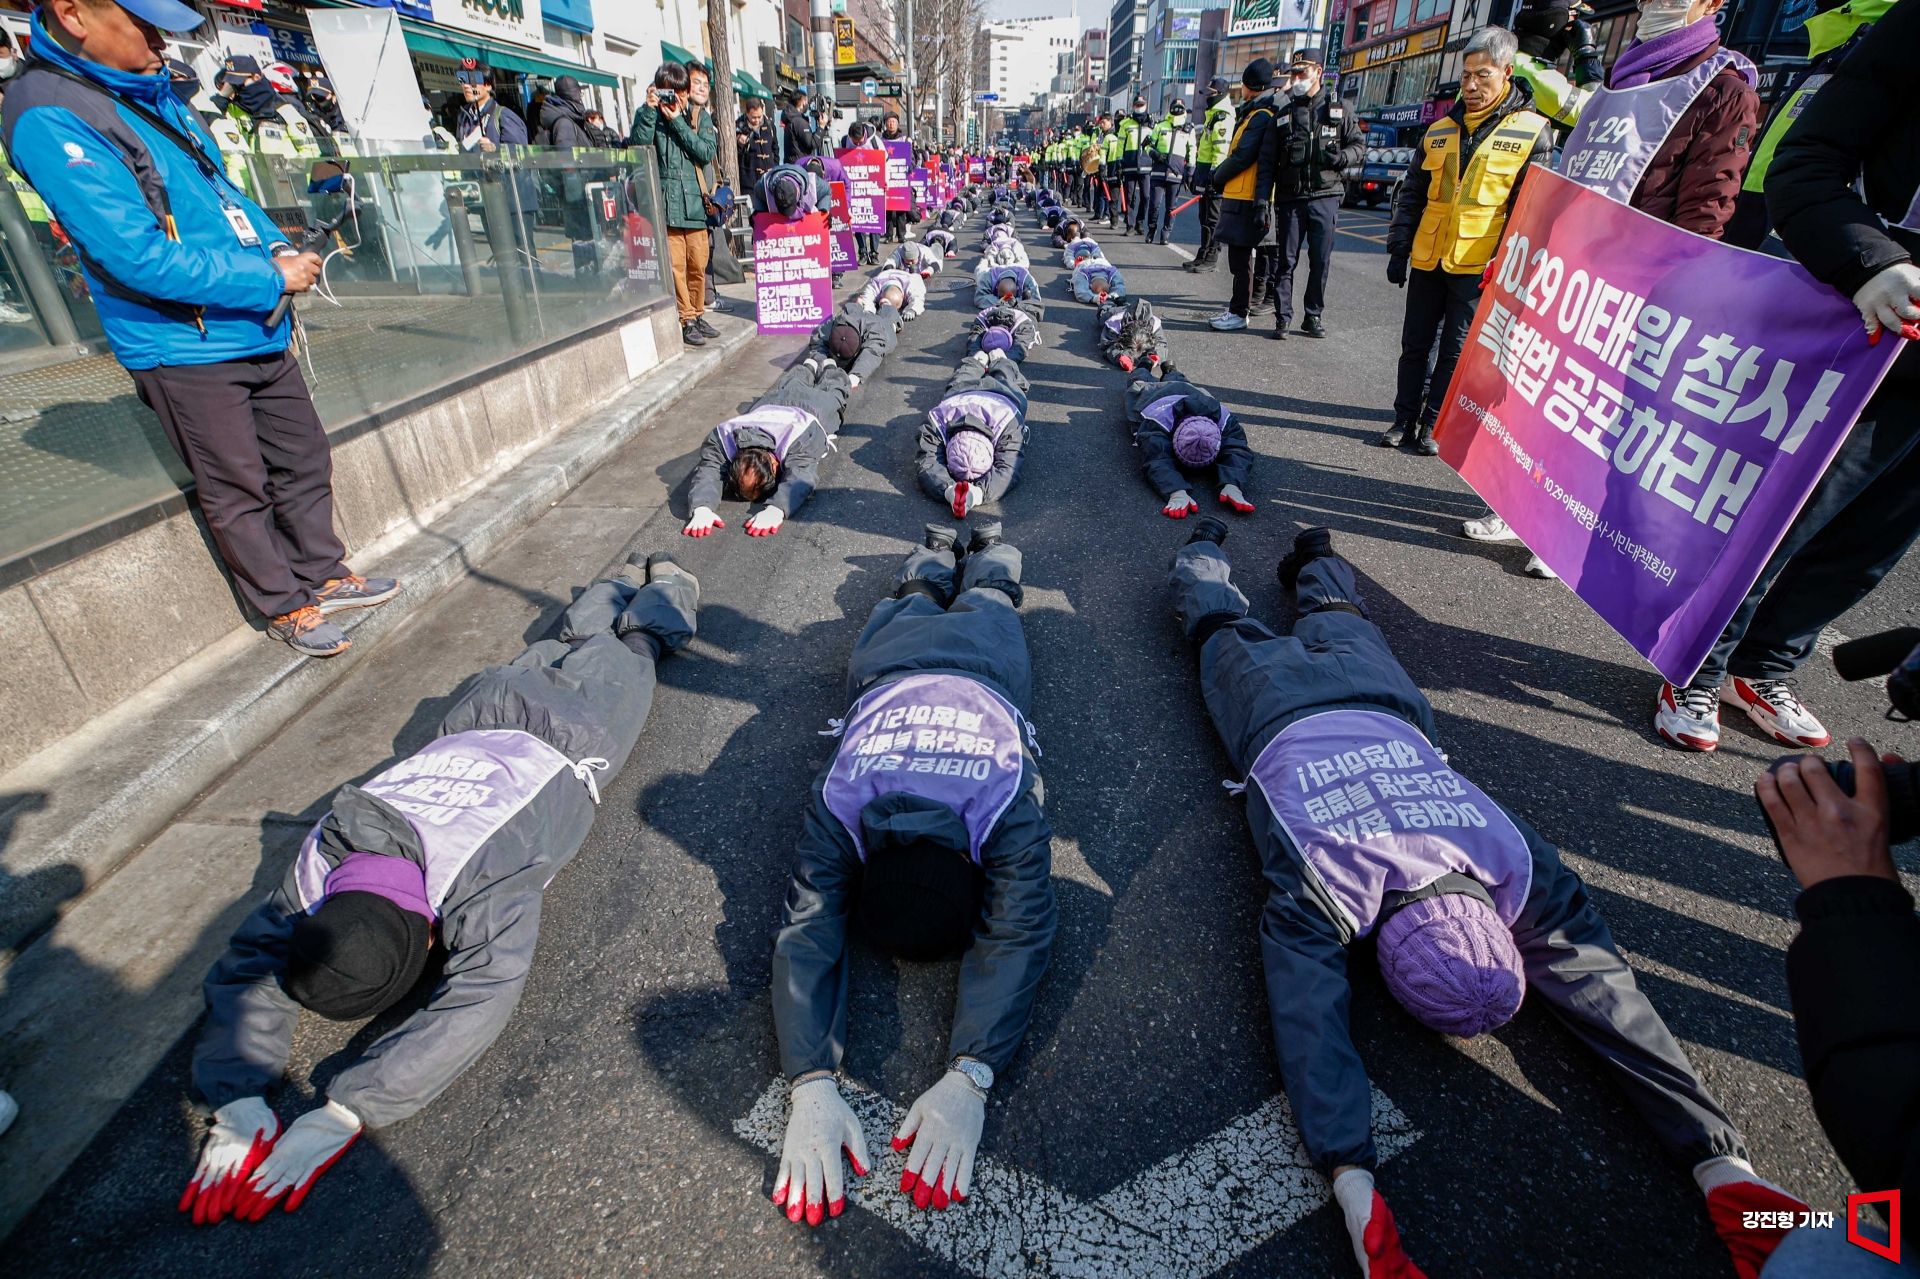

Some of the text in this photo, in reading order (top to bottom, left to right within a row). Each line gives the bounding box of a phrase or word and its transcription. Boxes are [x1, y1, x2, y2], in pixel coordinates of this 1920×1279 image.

[285, 51, 319, 65] FASHION
[1397, 110, 1418, 122] COFFEE
[1431, 138, 1521, 153] 민변 변호단
[1585, 150, 1629, 182] 참사
[1496, 231, 1845, 454] 10.29 이태원 참사
[1477, 298, 1763, 534] 특별법 공포하라!
[1543, 477, 1564, 500] 10.29
[1607, 530, 1677, 587] 시민대책회의
[914, 729, 996, 756] 진상규명
[849, 755, 991, 782] 이태원 참사
[1296, 739, 1424, 794] 제정하라!
[1303, 769, 1467, 824] 진상규명 특별법
[1327, 798, 1487, 846] 이태원 참사
